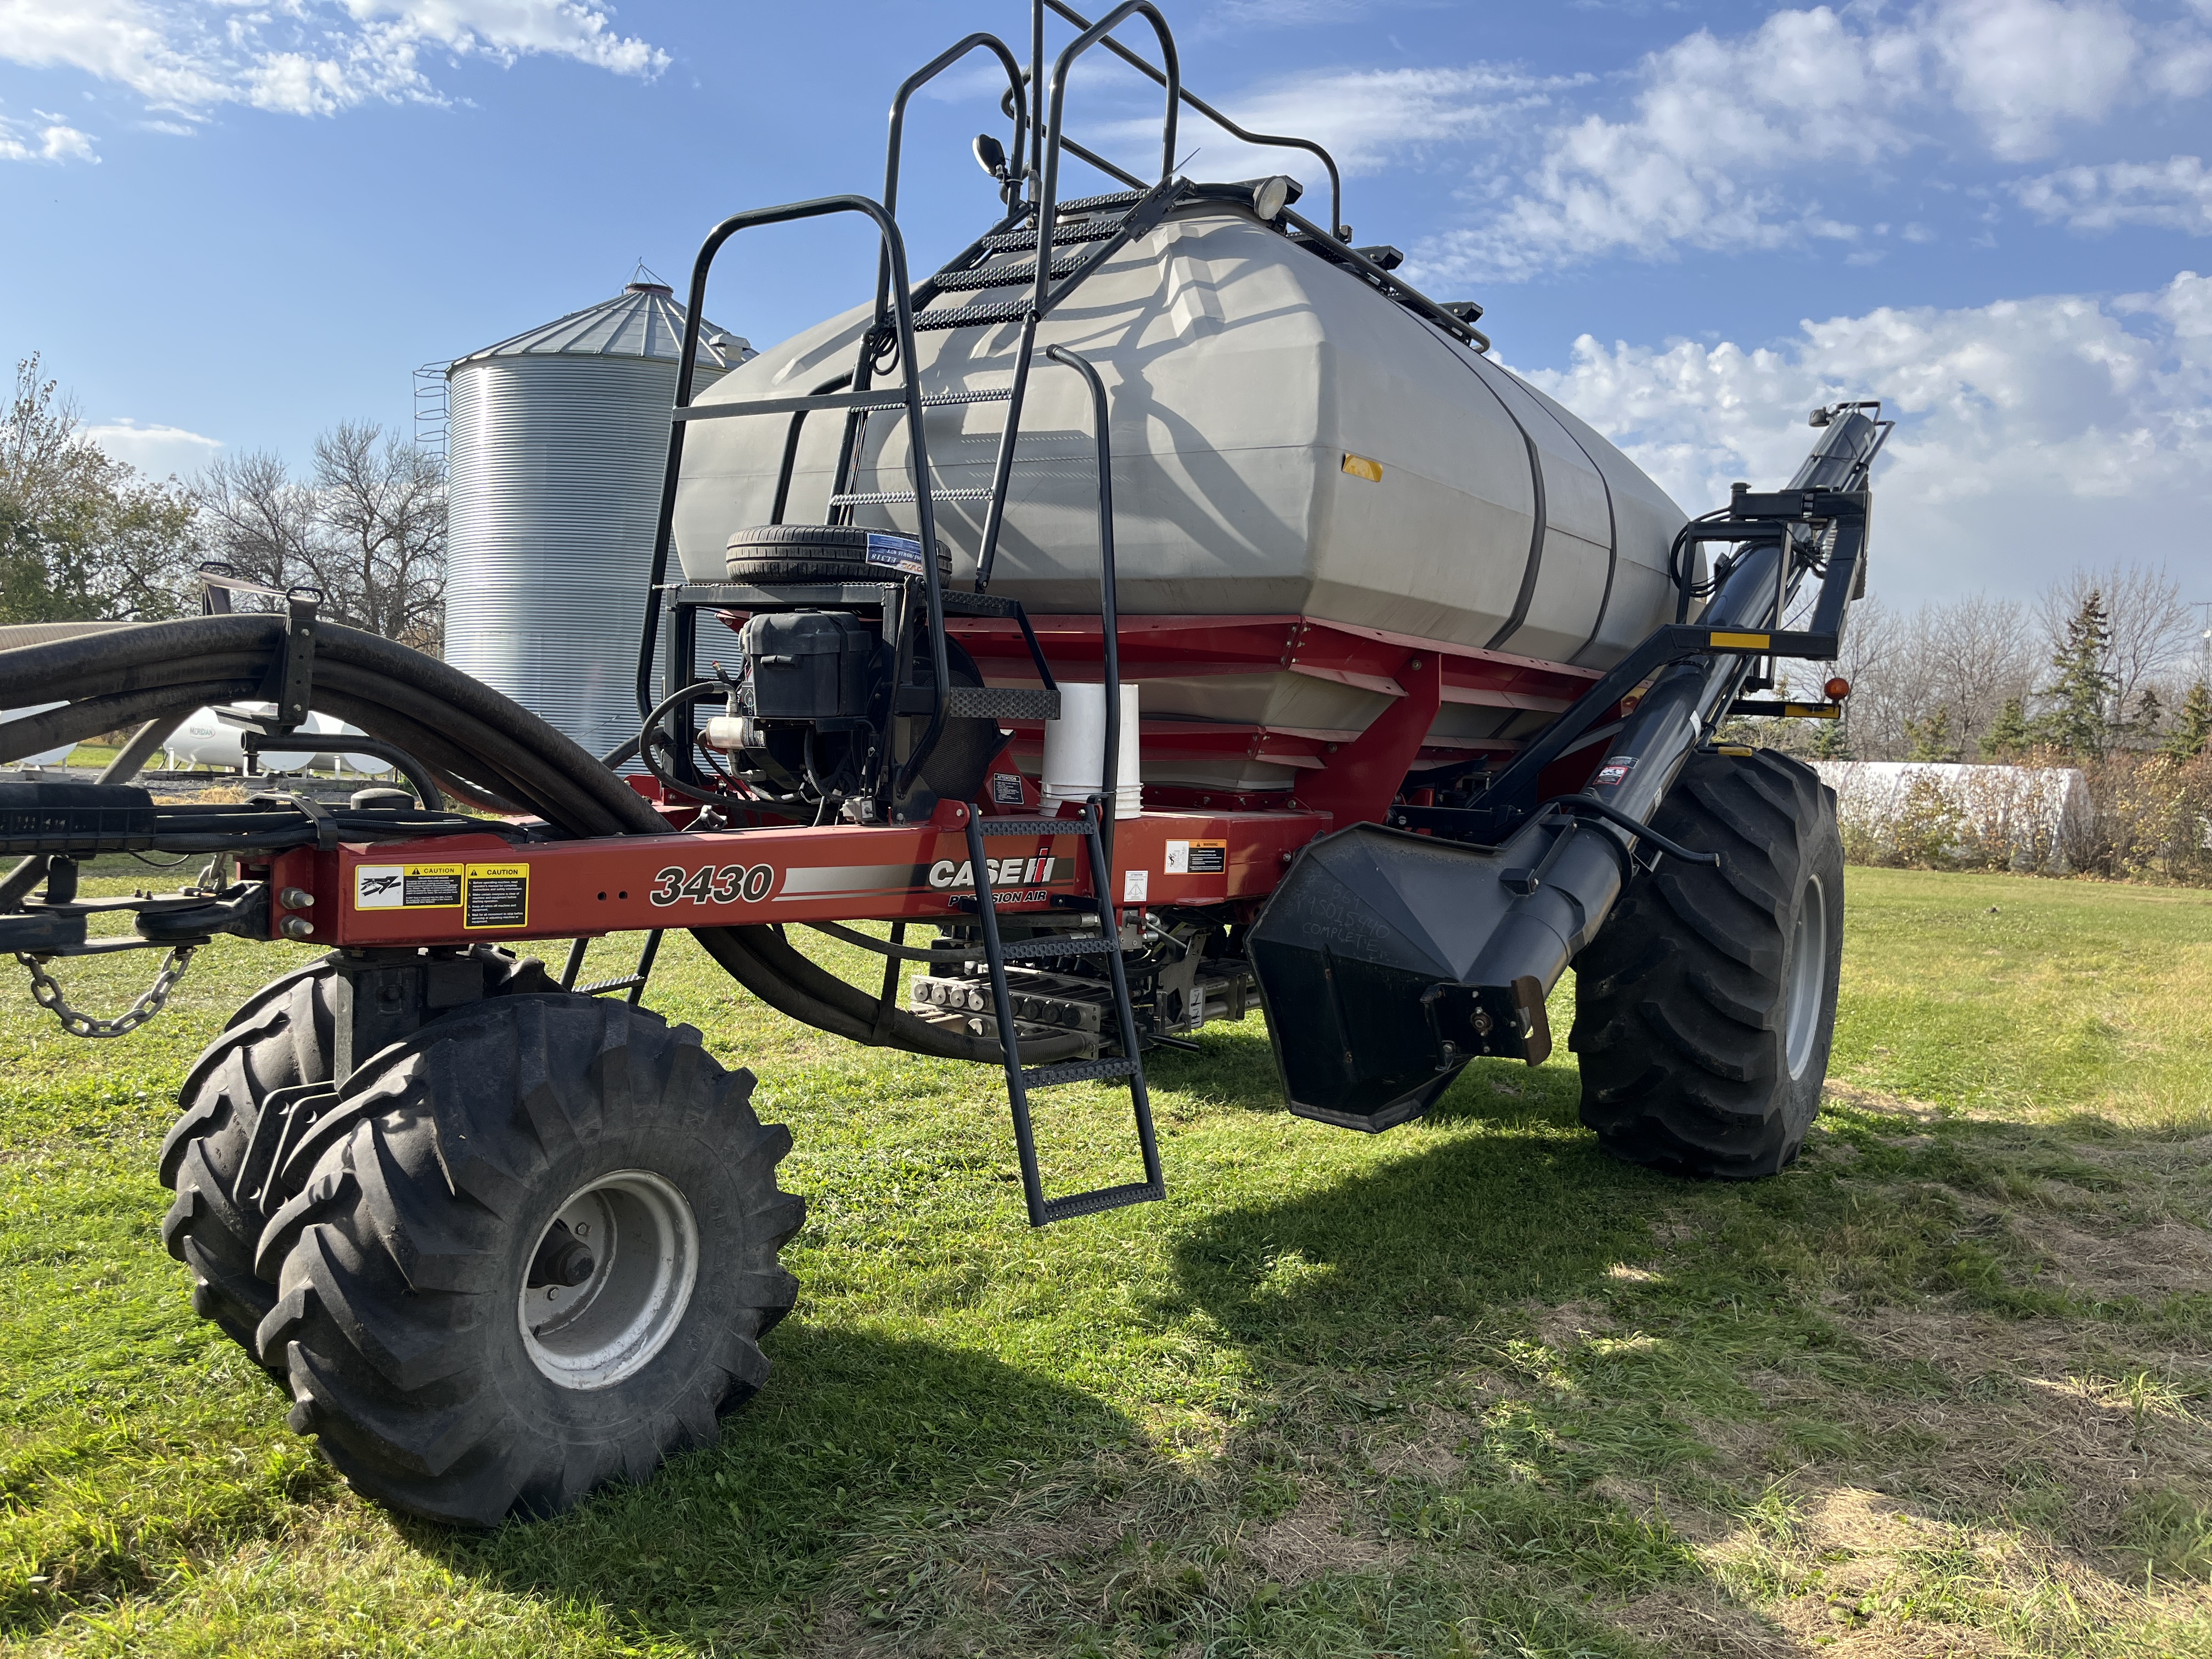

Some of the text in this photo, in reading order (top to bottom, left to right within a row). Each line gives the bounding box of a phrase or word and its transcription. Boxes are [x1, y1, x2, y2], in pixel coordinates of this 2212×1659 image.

[871, 553, 897, 563] EL318
[189, 726, 213, 736] MERIDIAN
[929, 858, 1024, 888] CASE
[650, 862, 774, 907] 3430
[1024, 890, 1047, 902] AIR
[1302, 922, 1379, 952] COMPLETE
